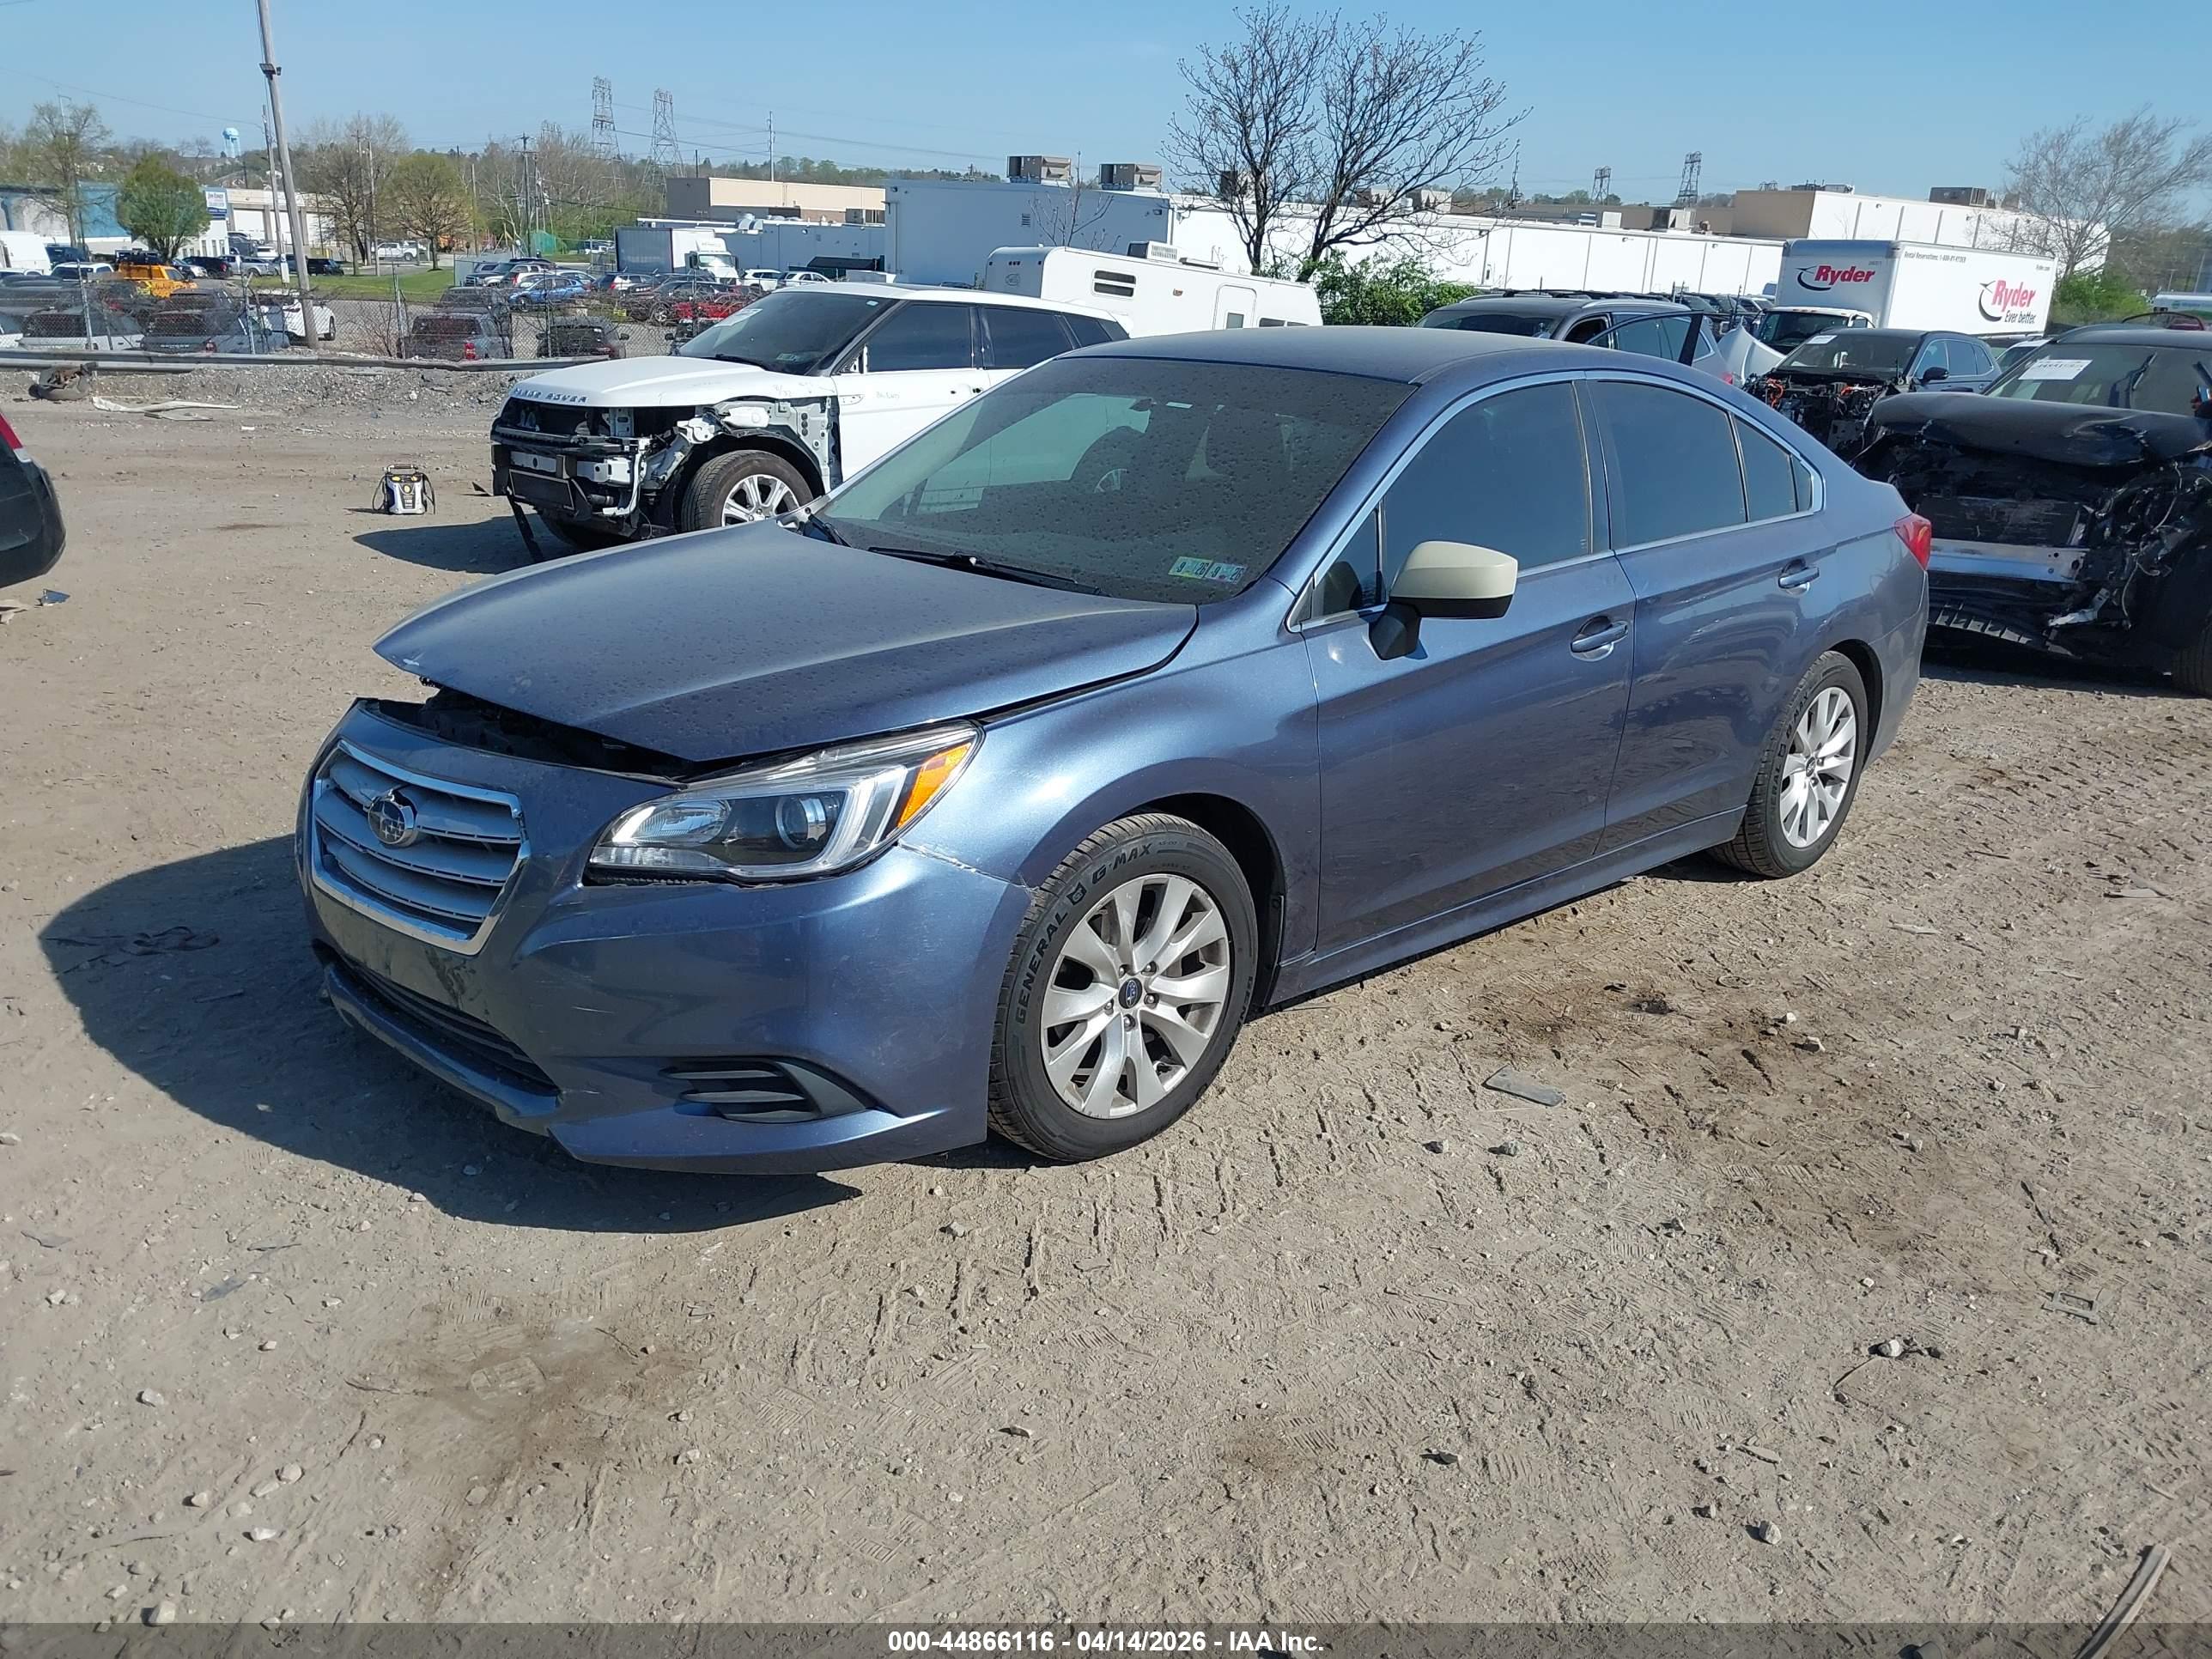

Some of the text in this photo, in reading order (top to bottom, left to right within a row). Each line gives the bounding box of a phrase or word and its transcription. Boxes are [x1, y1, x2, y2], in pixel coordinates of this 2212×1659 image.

[1814, 265, 1875, 285] Ryder
[1991, 279, 2036, 313] Ryder
[2004, 310, 2018, 323] Ever
[545, 392, 588, 403] ROVER
[1014, 910, 1068, 1024] GENERAL
